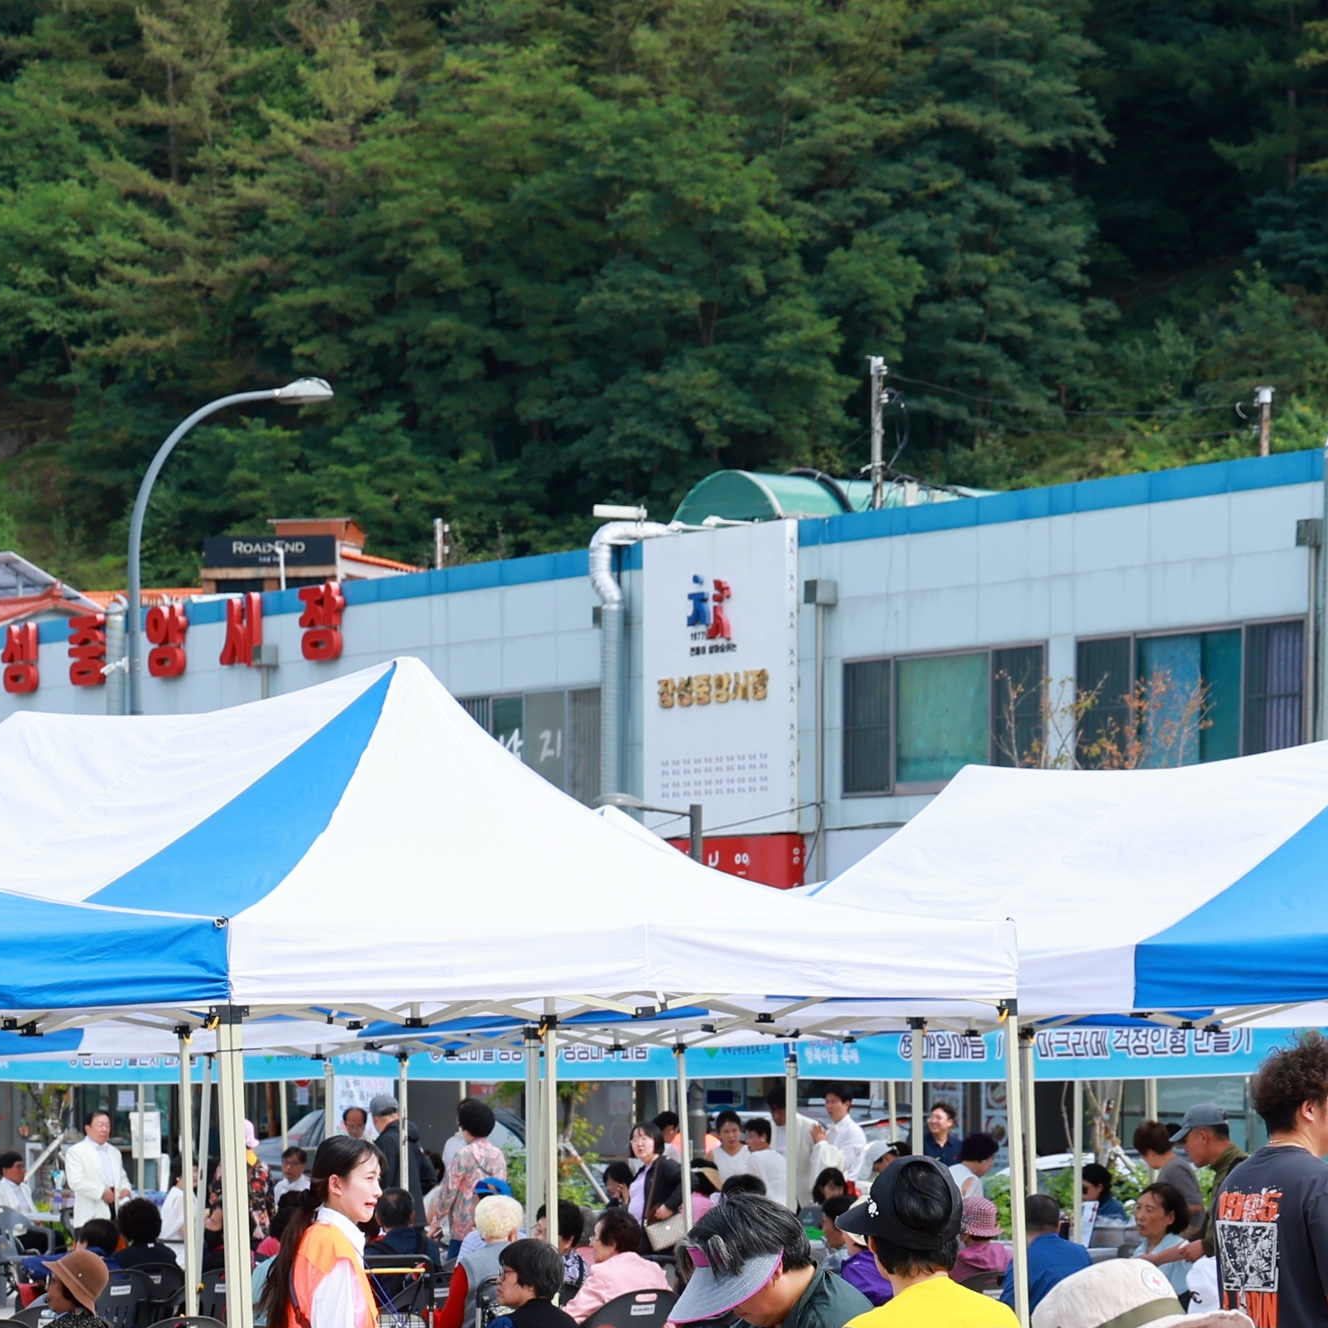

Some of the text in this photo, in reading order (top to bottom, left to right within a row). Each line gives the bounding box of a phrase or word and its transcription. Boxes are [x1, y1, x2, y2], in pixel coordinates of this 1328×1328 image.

[658, 668, 769, 709] 장성중앙시장
[1037, 1031, 1109, 1058] 마크라메
[1112, 1028, 1189, 1057] 걱정인형
[1193, 1027, 1253, 1055] 만들기
